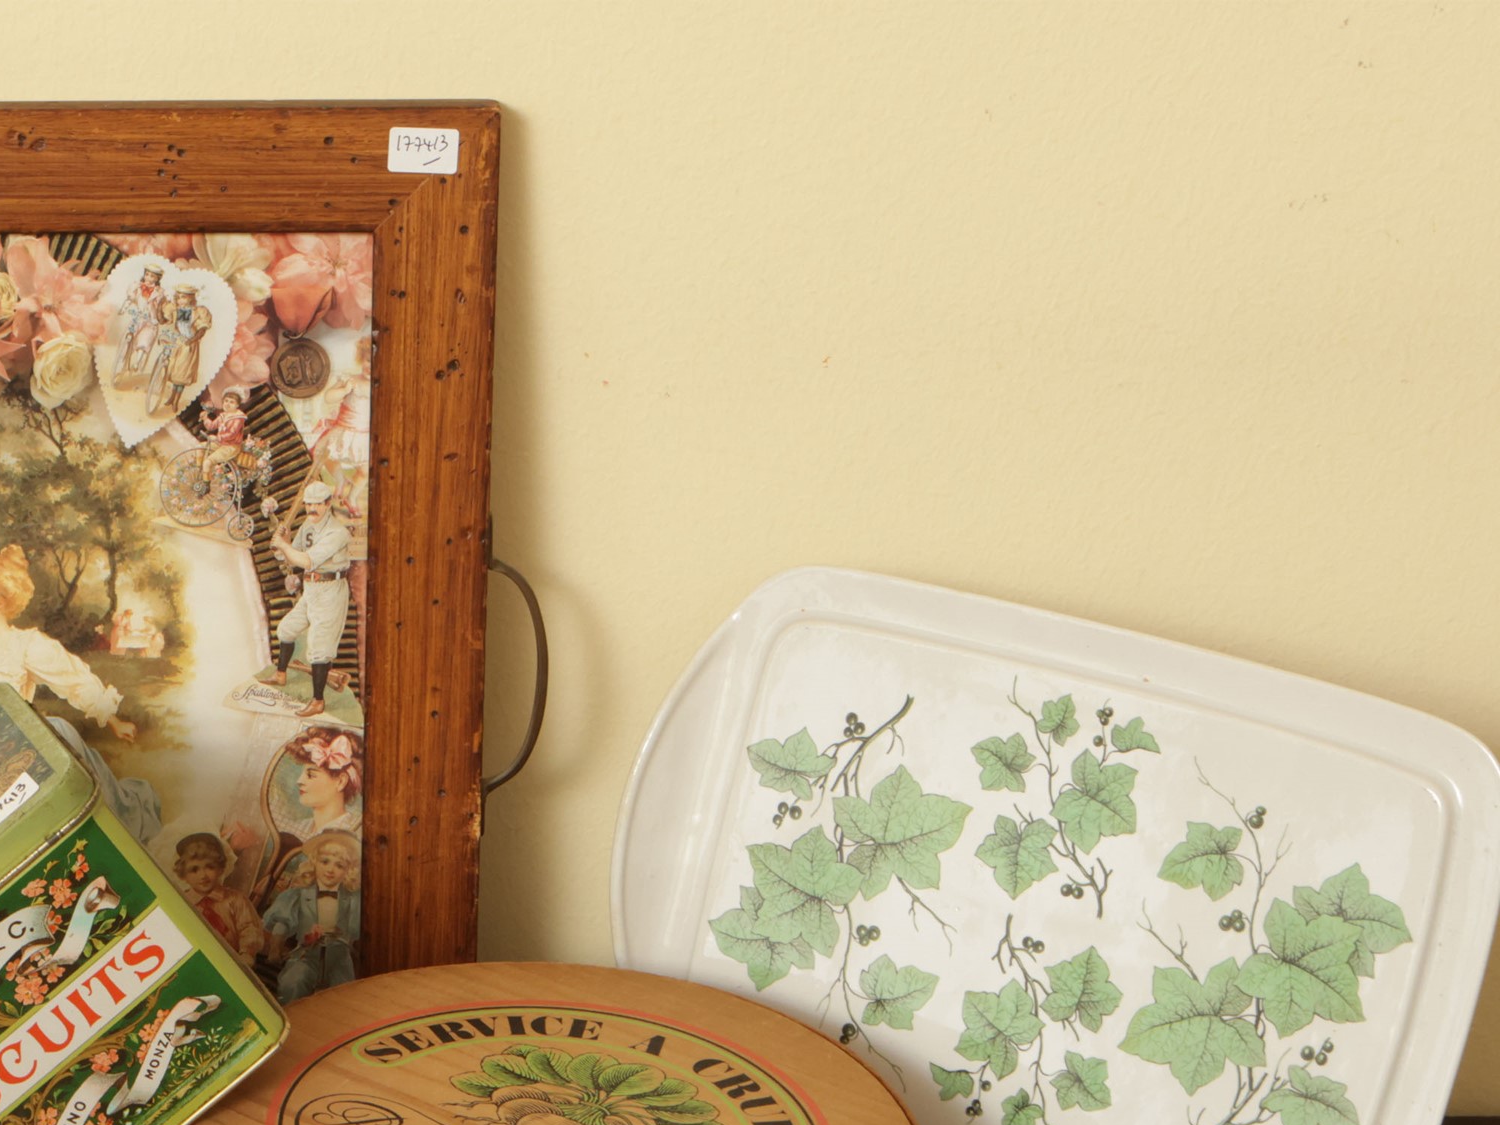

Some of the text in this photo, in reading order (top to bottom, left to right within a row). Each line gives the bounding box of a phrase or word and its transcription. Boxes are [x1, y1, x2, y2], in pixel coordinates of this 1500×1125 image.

[395, 133, 450, 153] 177413
[7, 919, 35, 940] C.
[143, 1029, 175, 1081] MONZA
[363, 1015, 604, 1064] SERVICE
[627, 1034, 667, 1057] A
